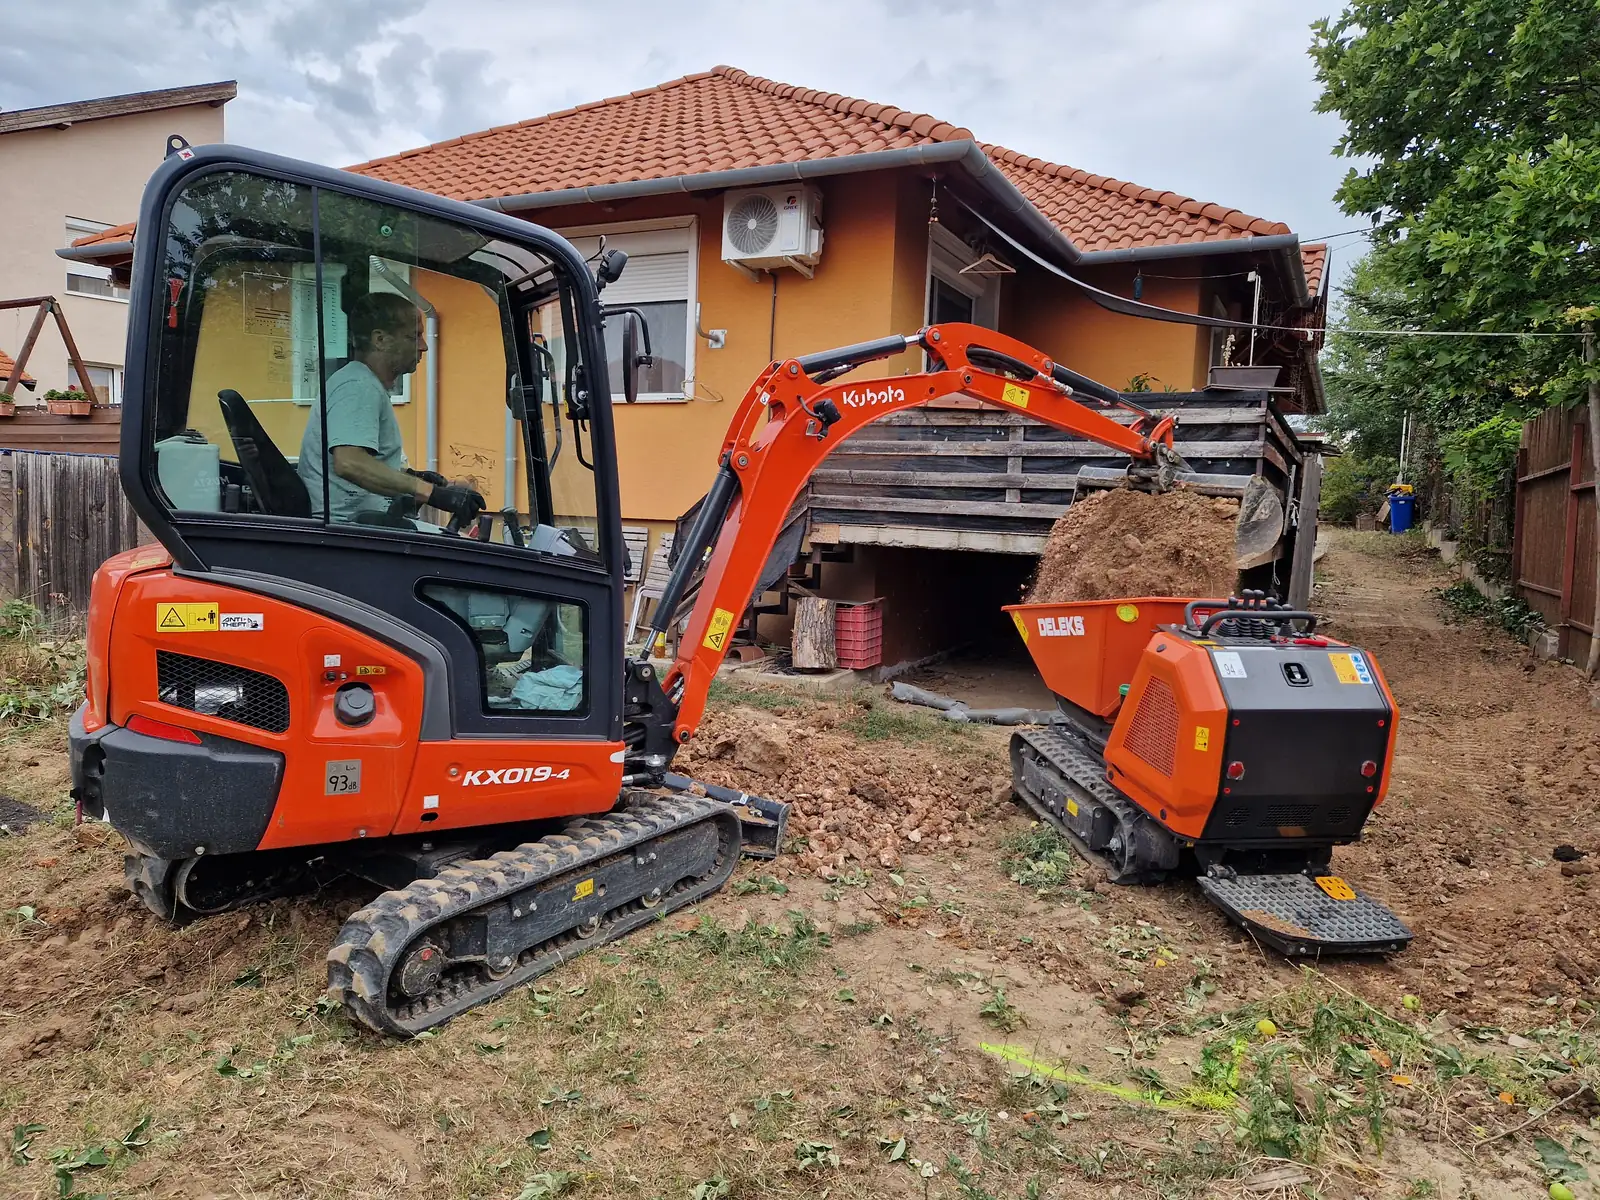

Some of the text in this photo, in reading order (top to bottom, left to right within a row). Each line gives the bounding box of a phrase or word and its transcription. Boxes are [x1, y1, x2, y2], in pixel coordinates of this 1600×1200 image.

[843, 386, 904, 407] Kubota
[1037, 616, 1084, 636] DELEKS
[1223, 664, 1236, 676] 94
[329, 774, 357, 792] 93 dB
[462, 766, 570, 786] KX019-4
